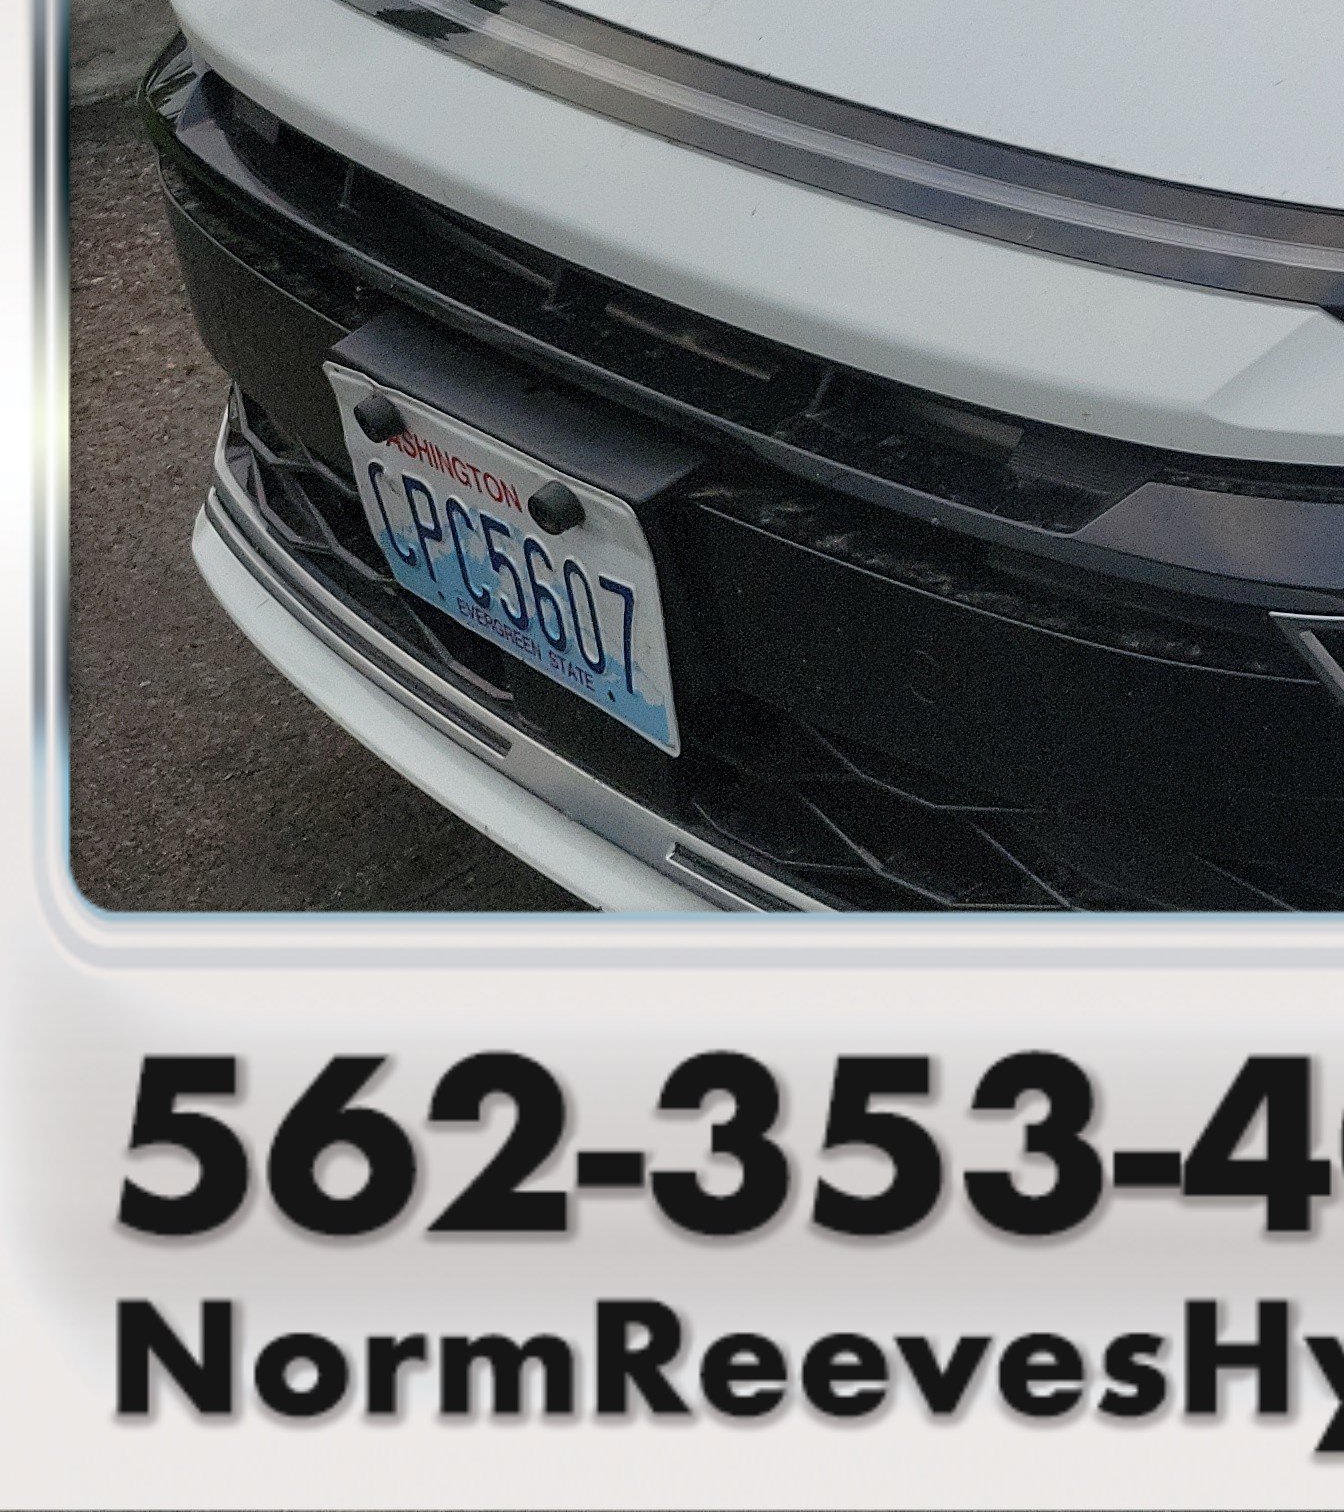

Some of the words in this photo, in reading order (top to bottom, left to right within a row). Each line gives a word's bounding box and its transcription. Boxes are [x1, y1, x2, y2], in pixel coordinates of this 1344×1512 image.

[384, 429, 523, 514] ASHINGTON
[367, 461, 635, 695] CPC5607
[456, 596, 542, 660] EVERGREEN
[549, 650, 595, 691] STATE
